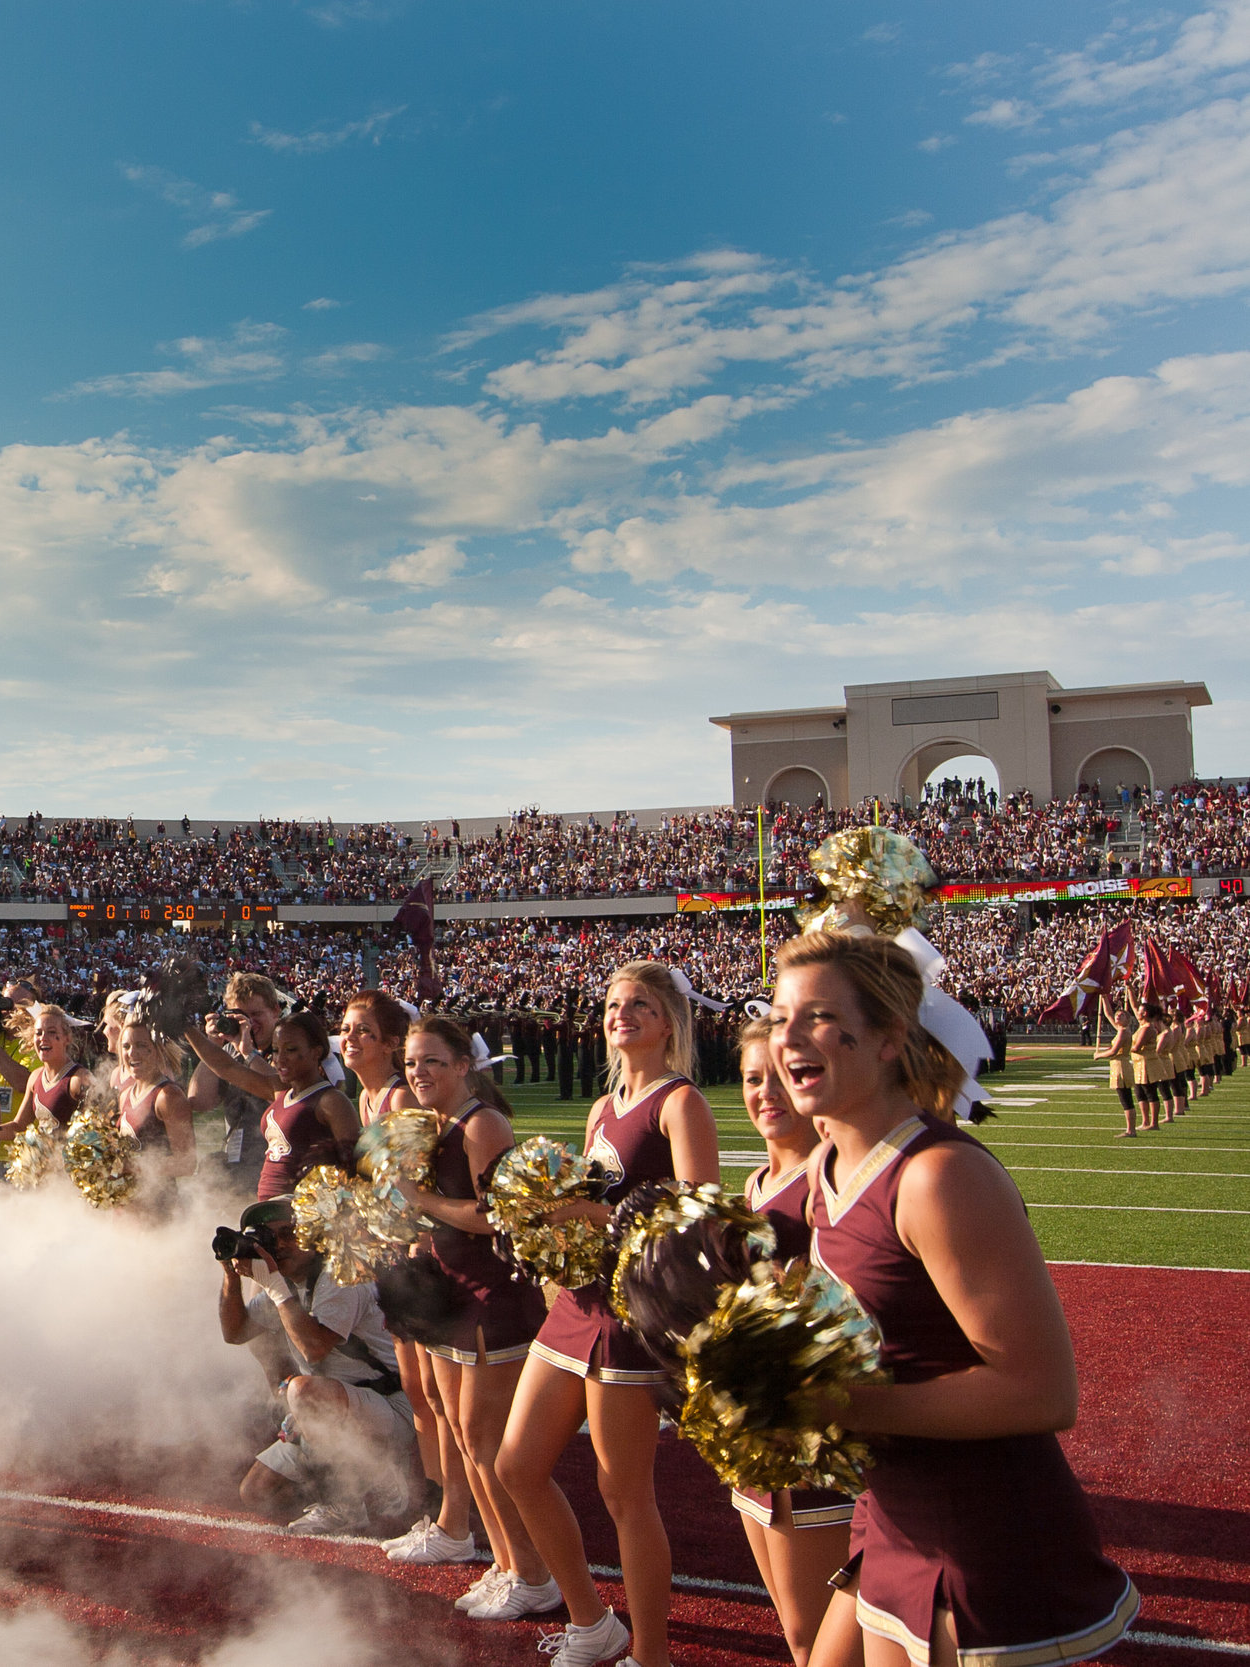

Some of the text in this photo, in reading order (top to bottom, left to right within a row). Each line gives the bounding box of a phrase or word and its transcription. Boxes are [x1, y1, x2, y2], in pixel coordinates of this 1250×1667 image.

[1067, 878, 1130, 898] NOISE
[1220, 879, 1243, 894] 40
[106, 904, 116, 919] 0
[140, 909, 150, 920] 10
[164, 904, 195, 920] 2:50
[241, 905, 251, 920] 0
